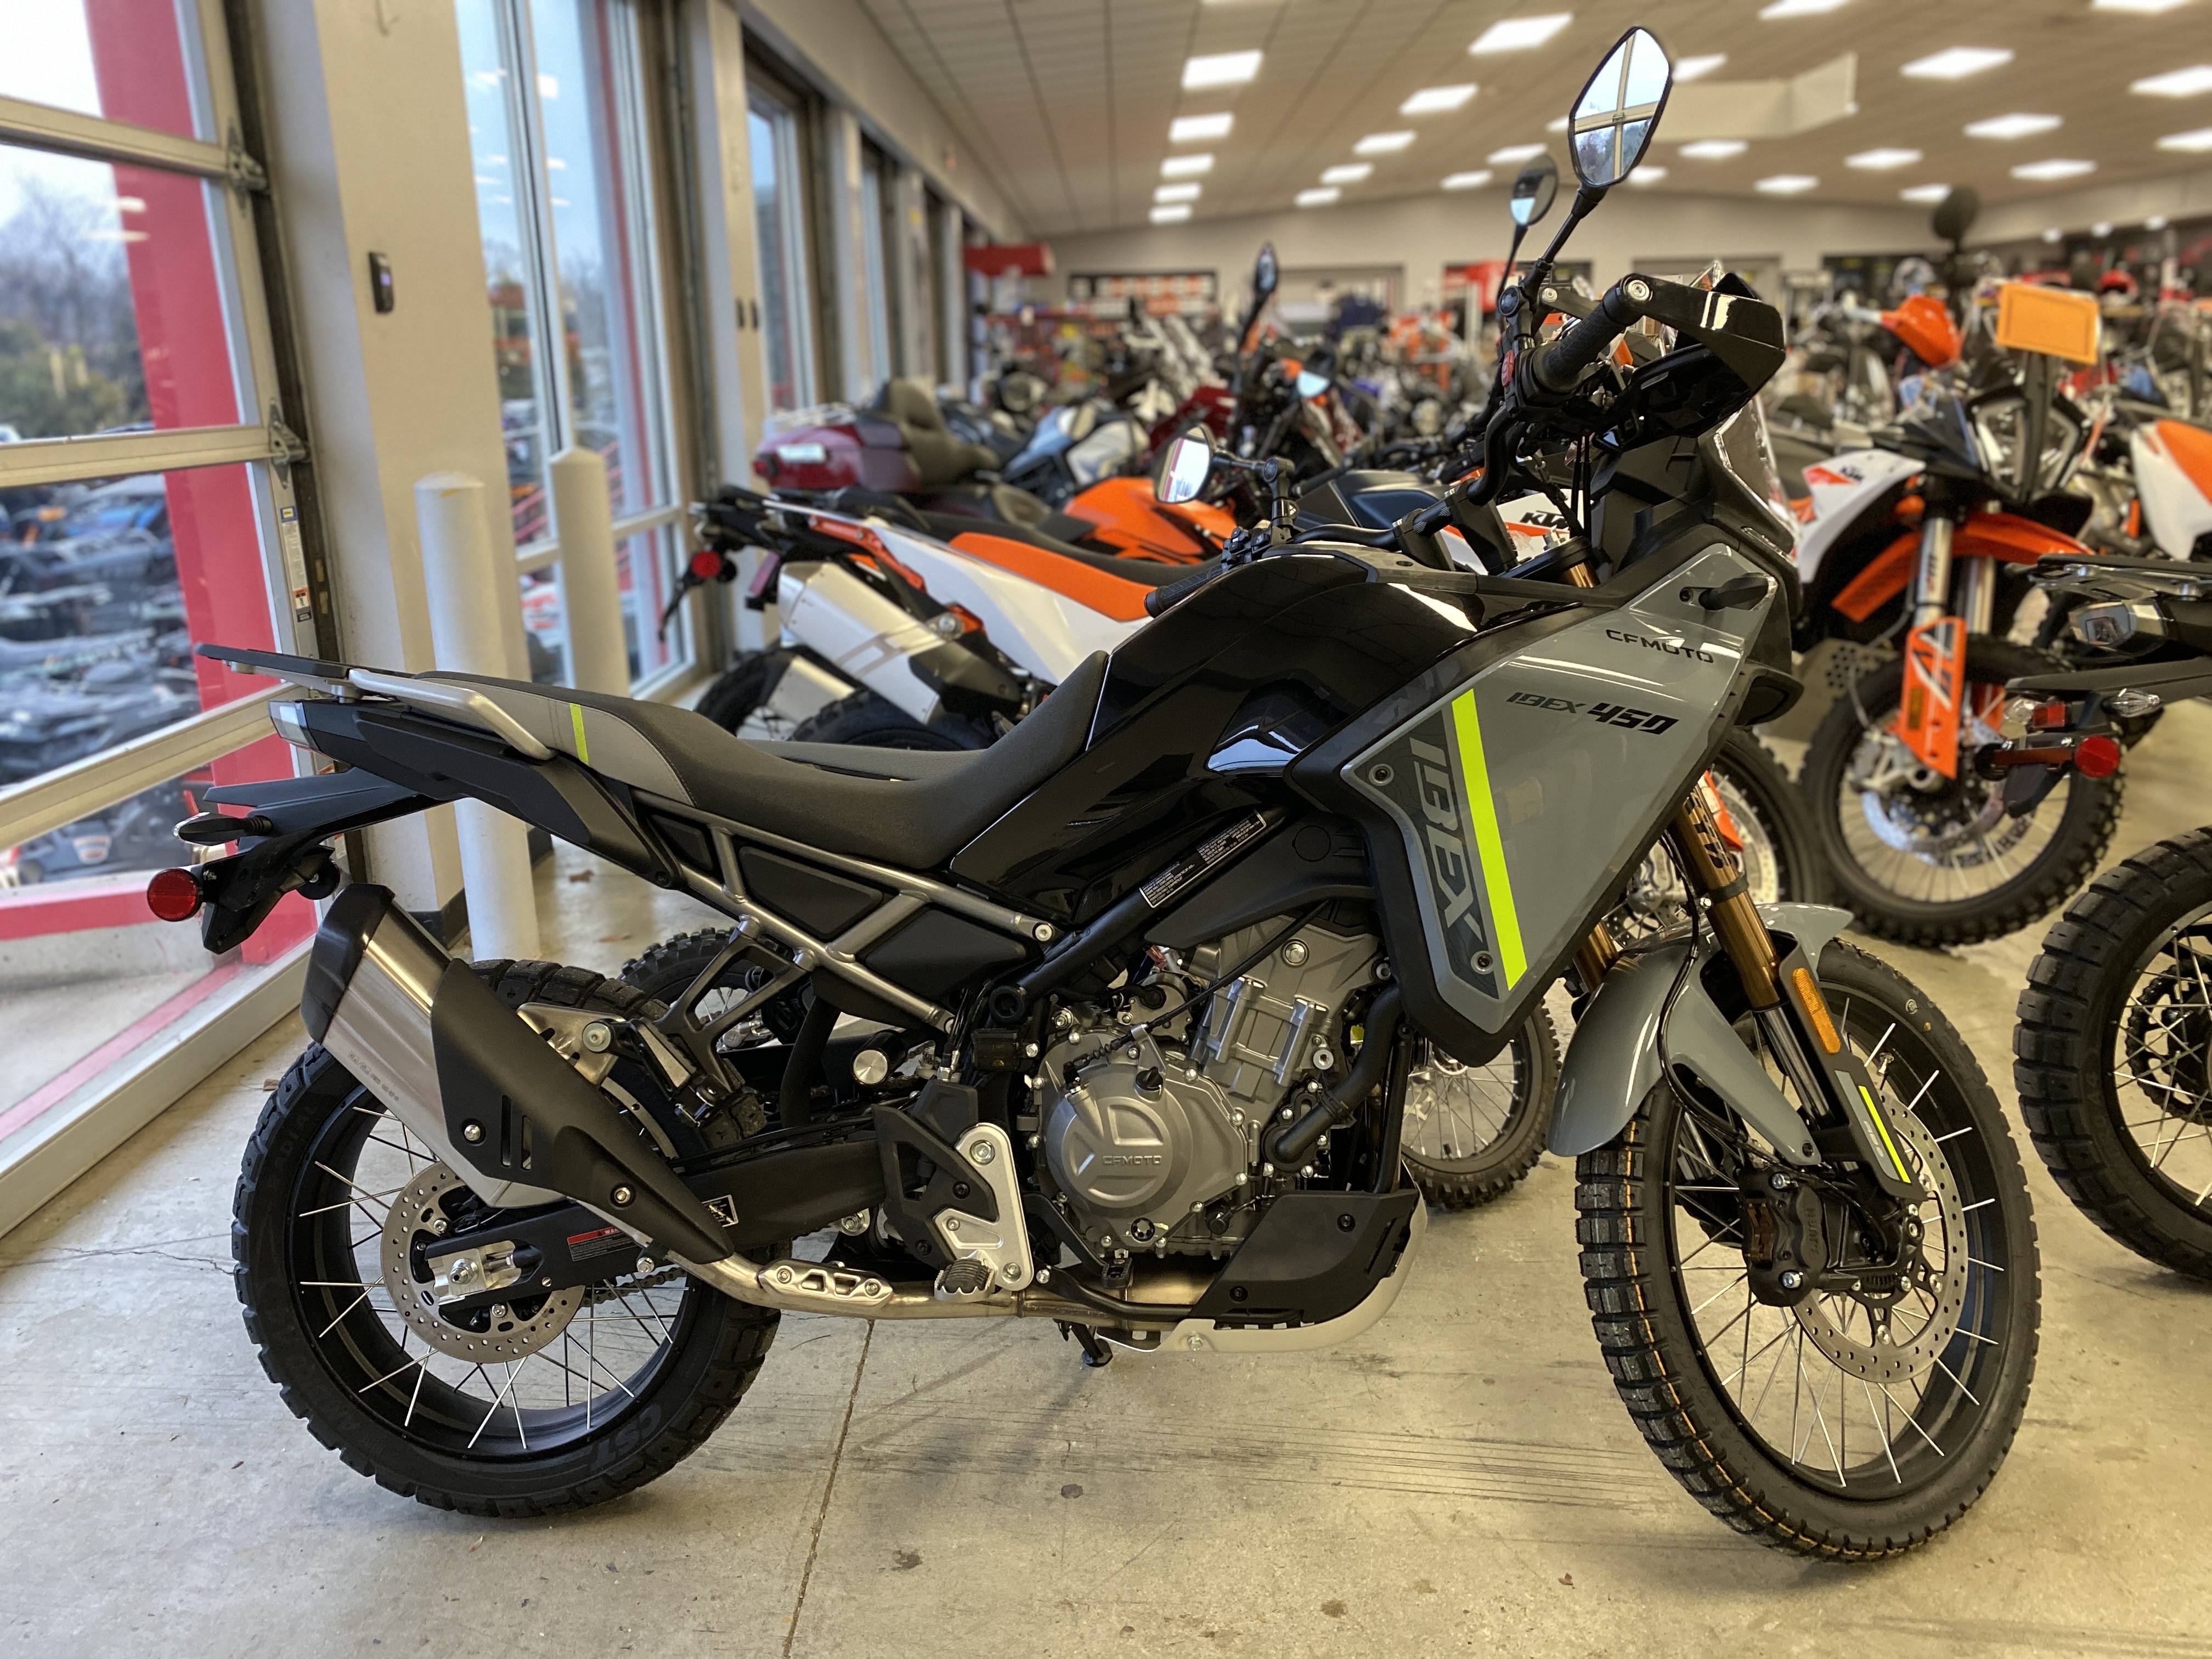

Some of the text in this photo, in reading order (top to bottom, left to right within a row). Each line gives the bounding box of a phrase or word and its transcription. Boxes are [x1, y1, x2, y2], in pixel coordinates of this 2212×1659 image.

[1606, 629, 1714, 664] CFMOTO
[1506, 692, 1680, 735] IBEX 450
[1409, 736, 1484, 942] IBEX
[1103, 1155, 1163, 1164] CFMOTO
